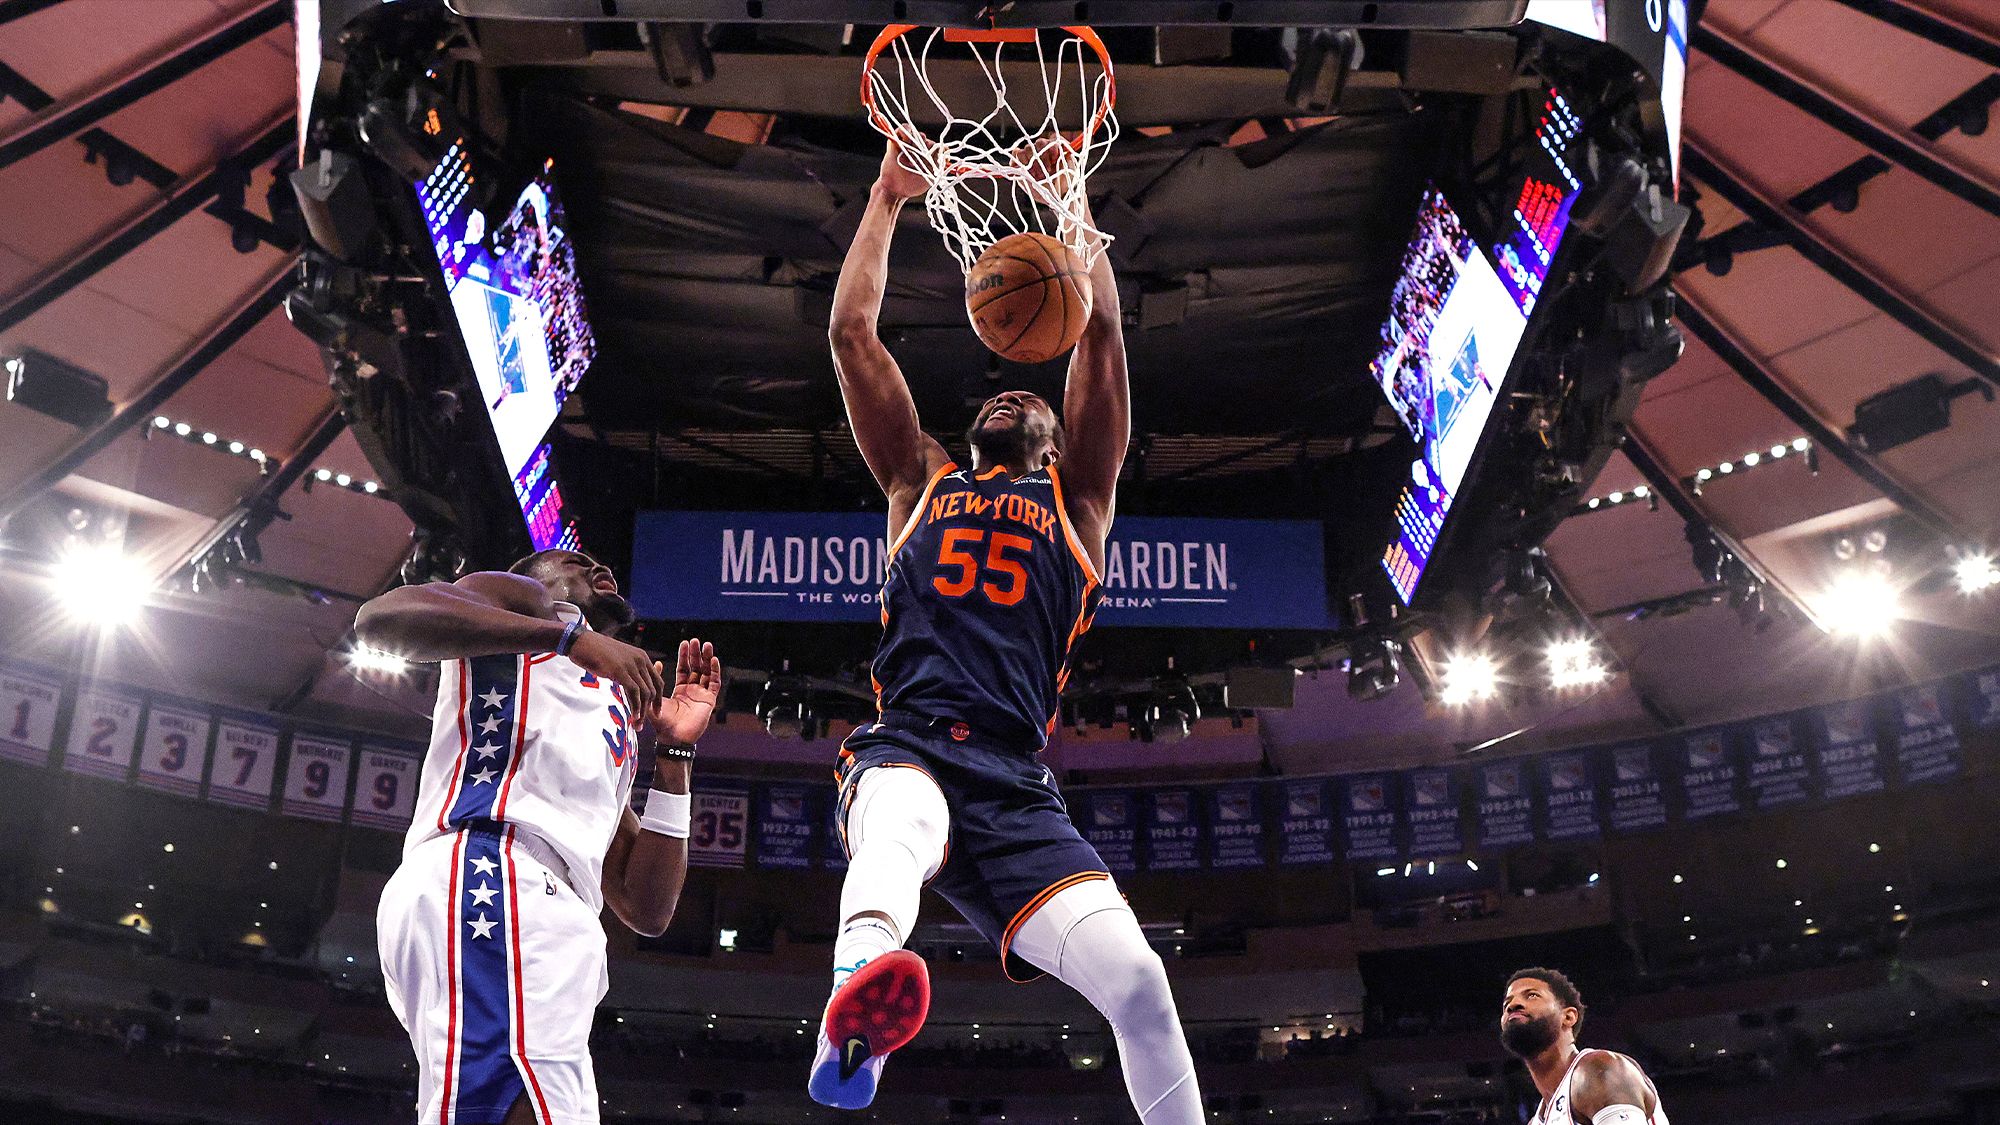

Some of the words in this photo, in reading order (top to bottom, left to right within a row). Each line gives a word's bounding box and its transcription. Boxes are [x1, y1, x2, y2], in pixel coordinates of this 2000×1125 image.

[928, 491, 993, 525] NEW
[993, 493, 1057, 544] YORK
[932, 527, 1033, 607] 55
[1106, 541, 1228, 590] ARDEN
[797, 592, 833, 603] THE
[1103, 597, 1152, 608] RENA
[11, 698, 31, 740] 1
[86, 716, 118, 757] 2
[160, 733, 188, 772] 3
[232, 747, 259, 787] 7
[303, 760, 330, 799] 9
[371, 772, 399, 811] 9
[694, 811, 743, 848] 35
